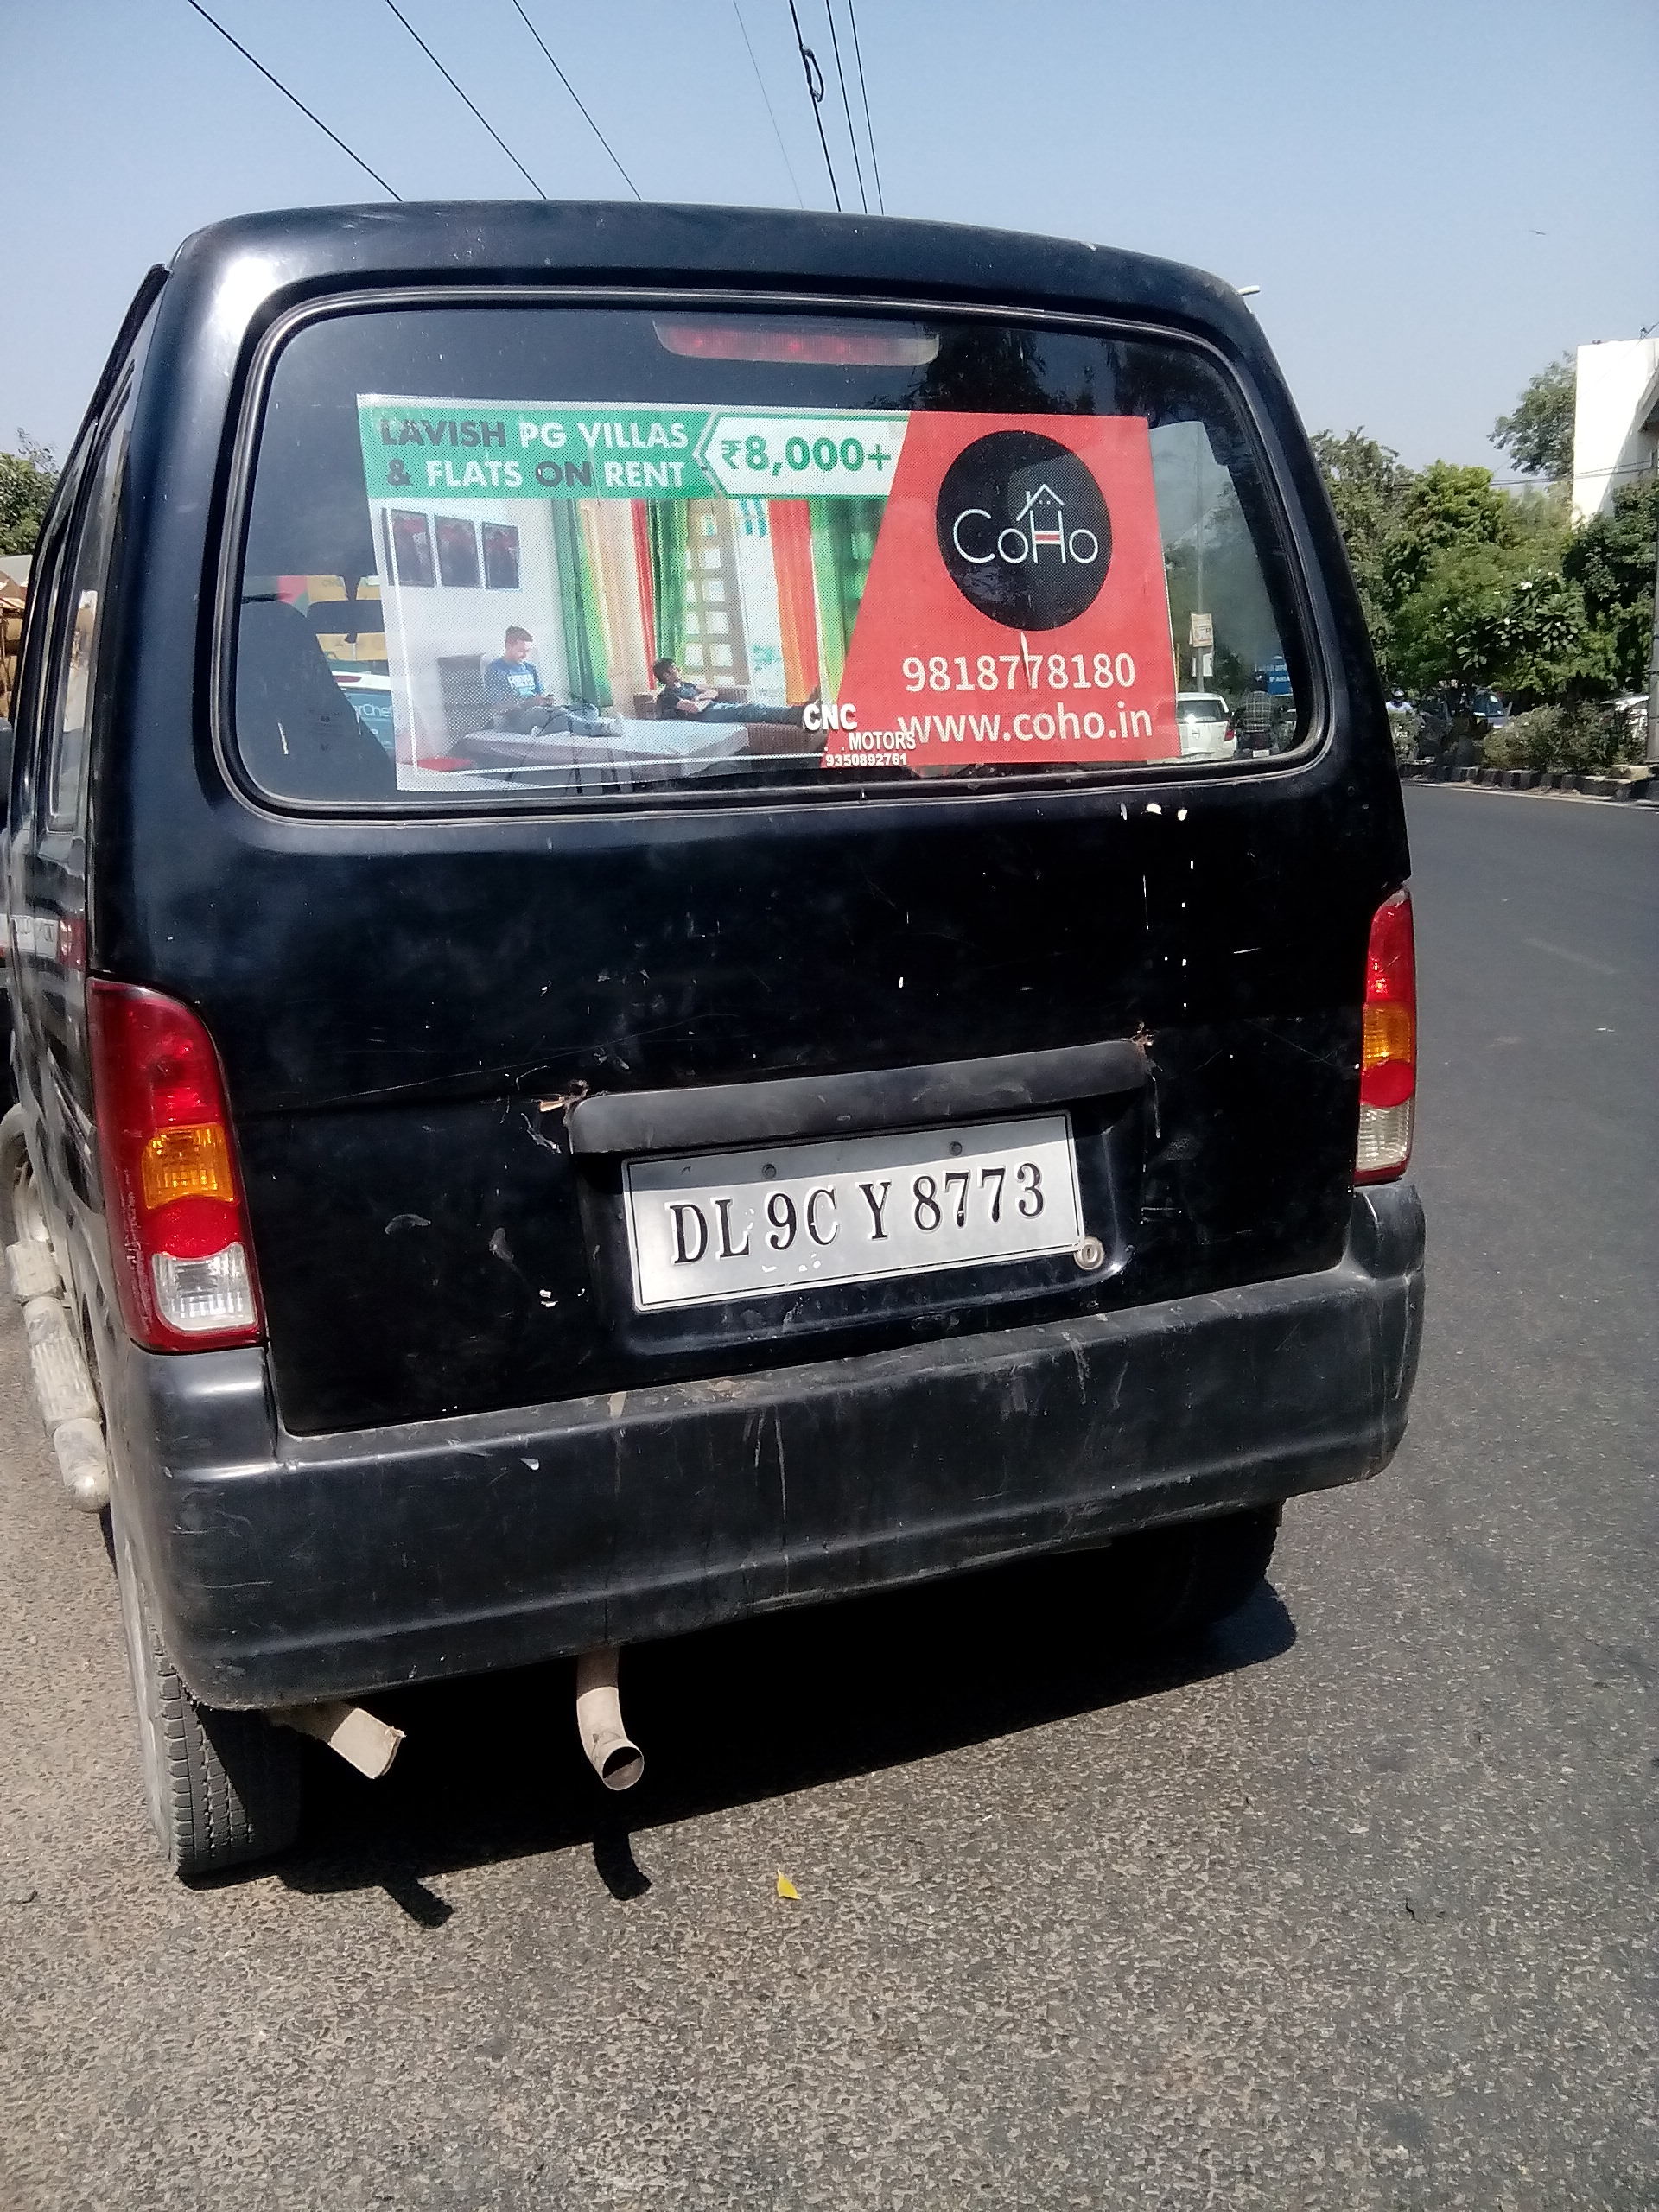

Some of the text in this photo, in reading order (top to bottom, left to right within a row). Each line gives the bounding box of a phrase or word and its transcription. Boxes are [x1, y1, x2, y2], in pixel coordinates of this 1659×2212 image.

[380, 418, 689, 449] LAVISH PG VILLAS
[388, 458, 686, 488] & FLATS ON RENT
[901, 652, 1135, 693] 9818778180
[849, 731, 916, 751] MOTORS
[897, 701, 1154, 745] www.coho.in
[669, 1161, 1046, 1265] DL 9C Y 8773
